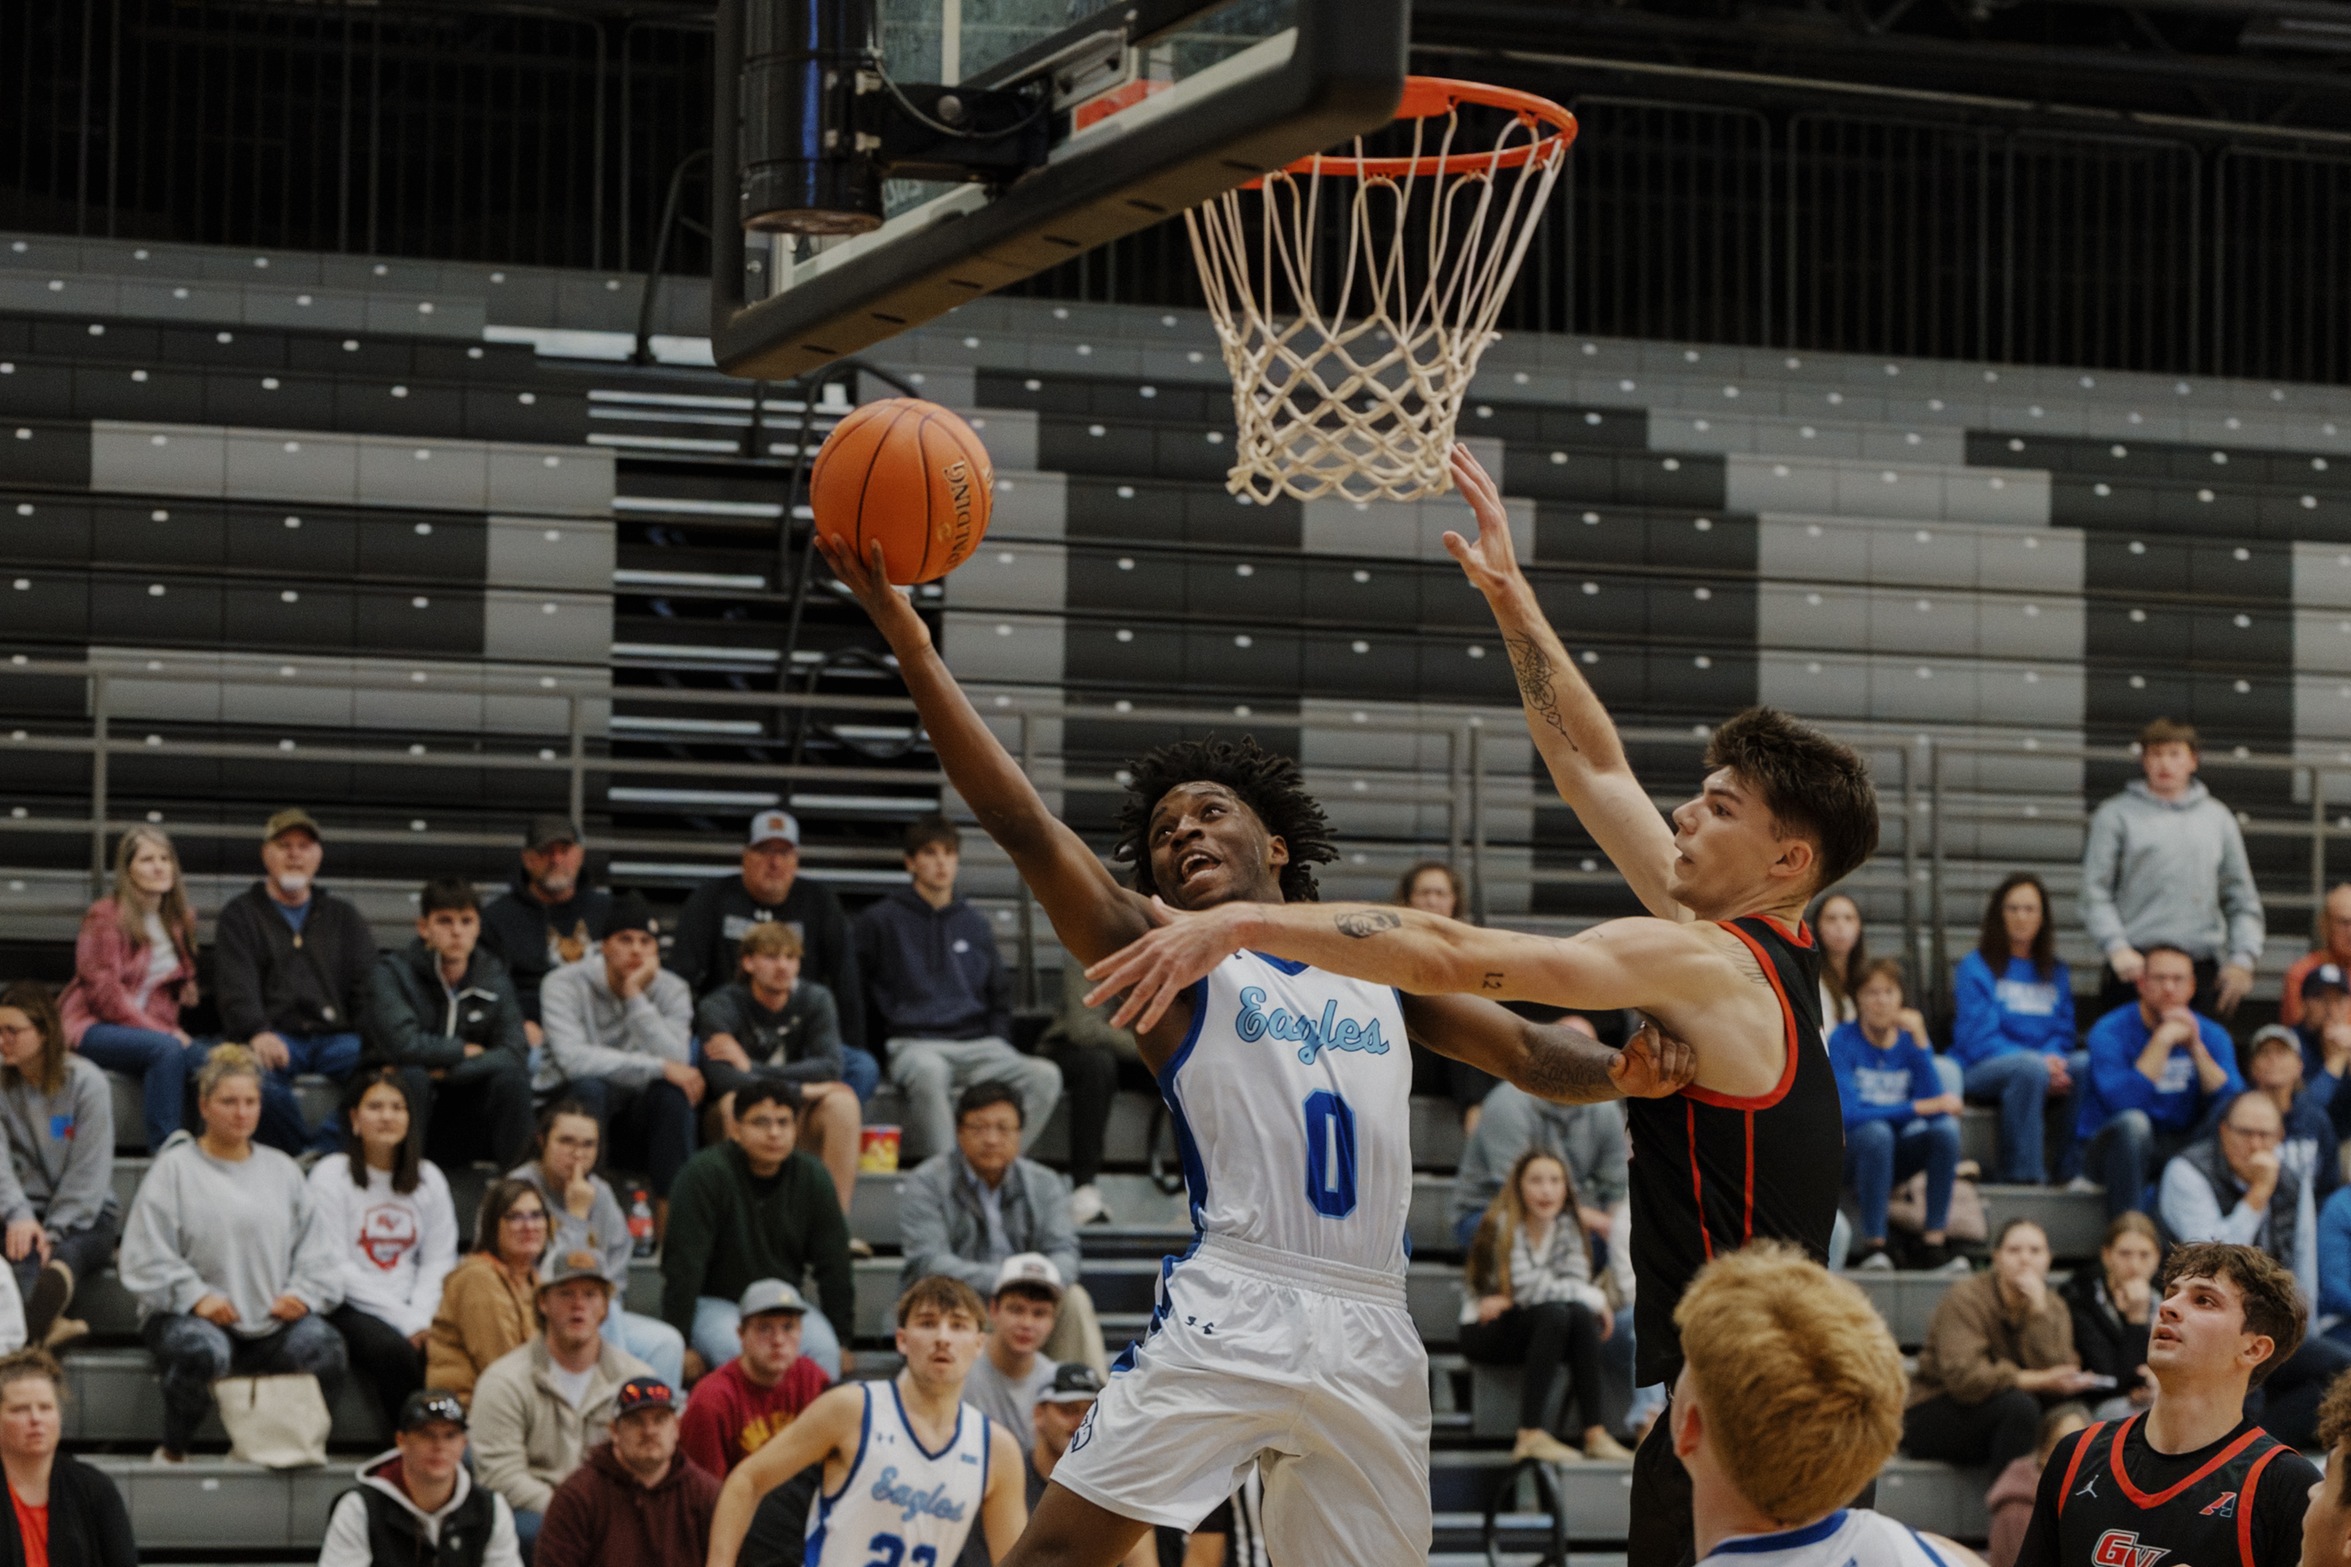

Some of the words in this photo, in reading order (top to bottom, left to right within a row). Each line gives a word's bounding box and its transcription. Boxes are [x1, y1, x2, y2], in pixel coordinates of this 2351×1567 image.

[1235, 985, 1390, 1065] Eagles
[1302, 1087, 1358, 1220] 0
[871, 1466, 966, 1522] Eagles
